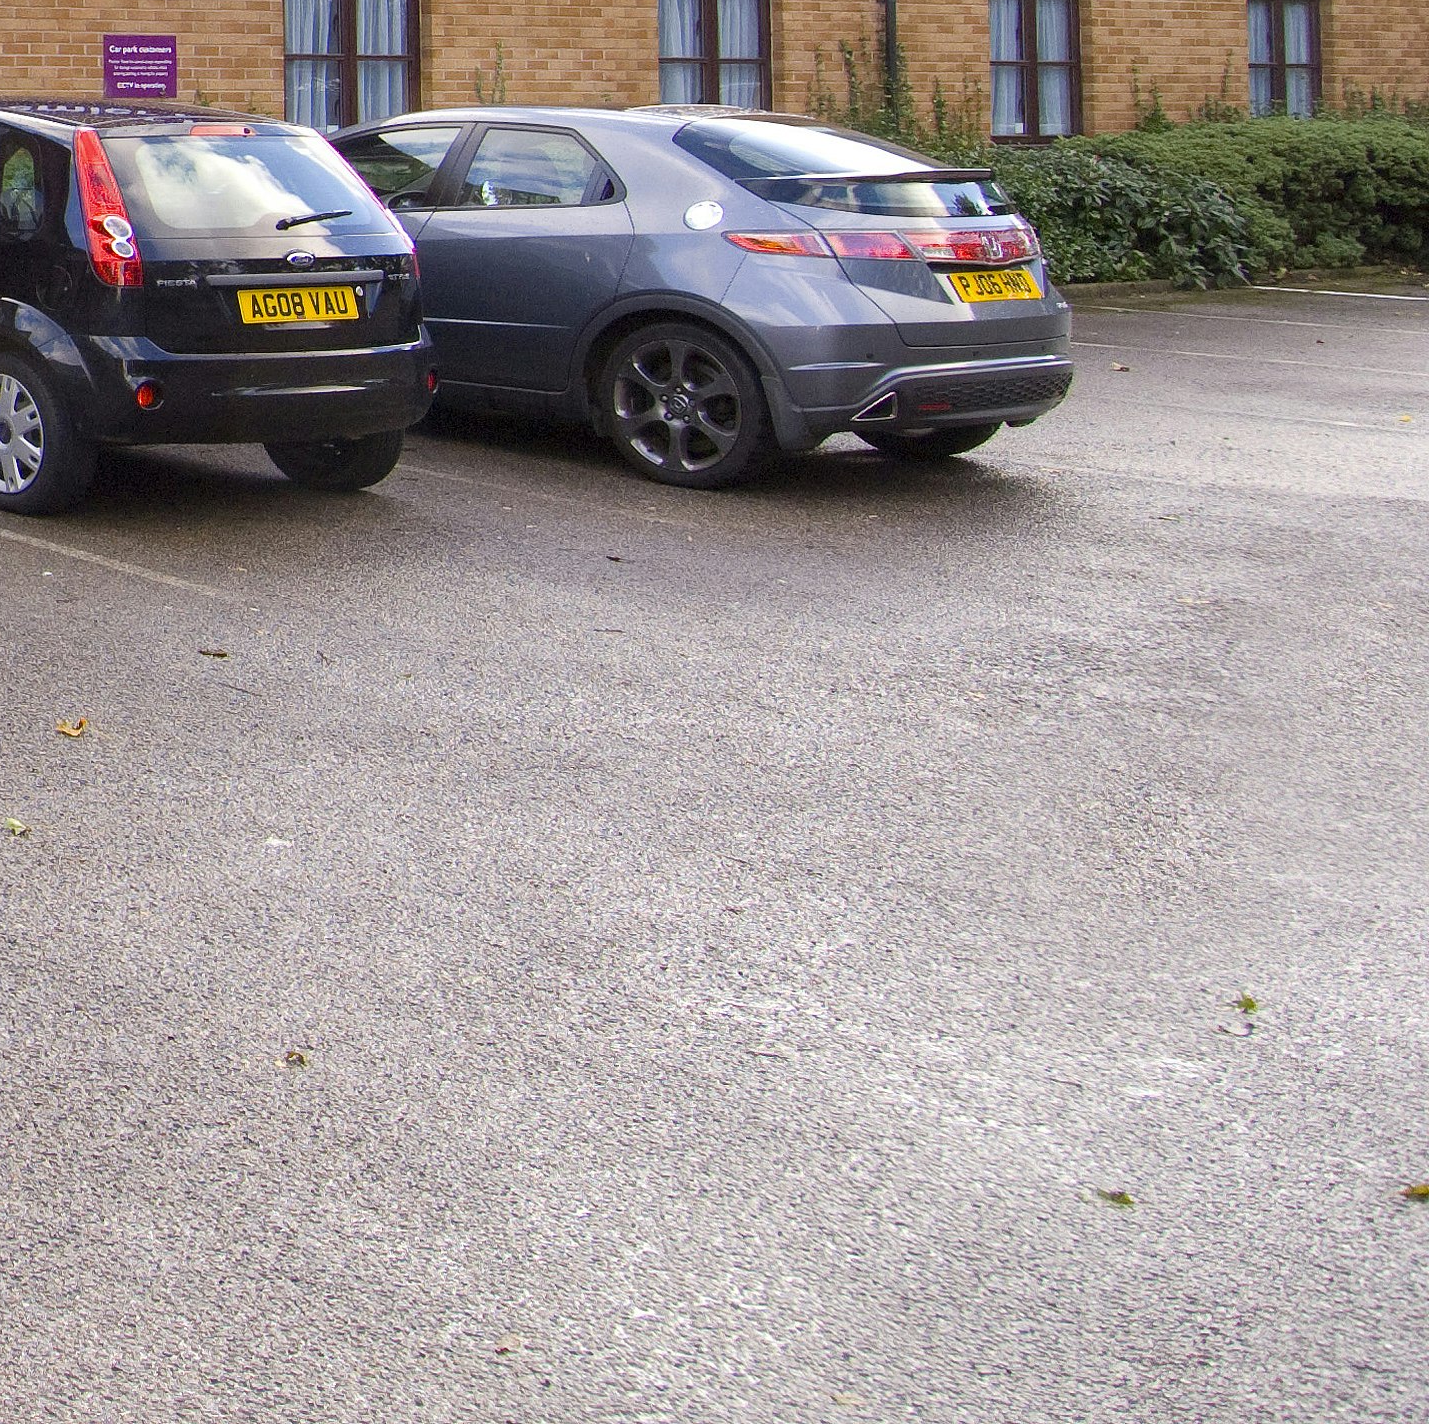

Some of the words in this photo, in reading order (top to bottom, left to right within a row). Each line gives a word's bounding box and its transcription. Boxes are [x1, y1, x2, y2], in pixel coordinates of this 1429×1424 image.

[109, 45, 121, 53] Car
[123, 45, 138, 54] park
[251, 292, 306, 318] AG08
[308, 291, 349, 315] VAU
